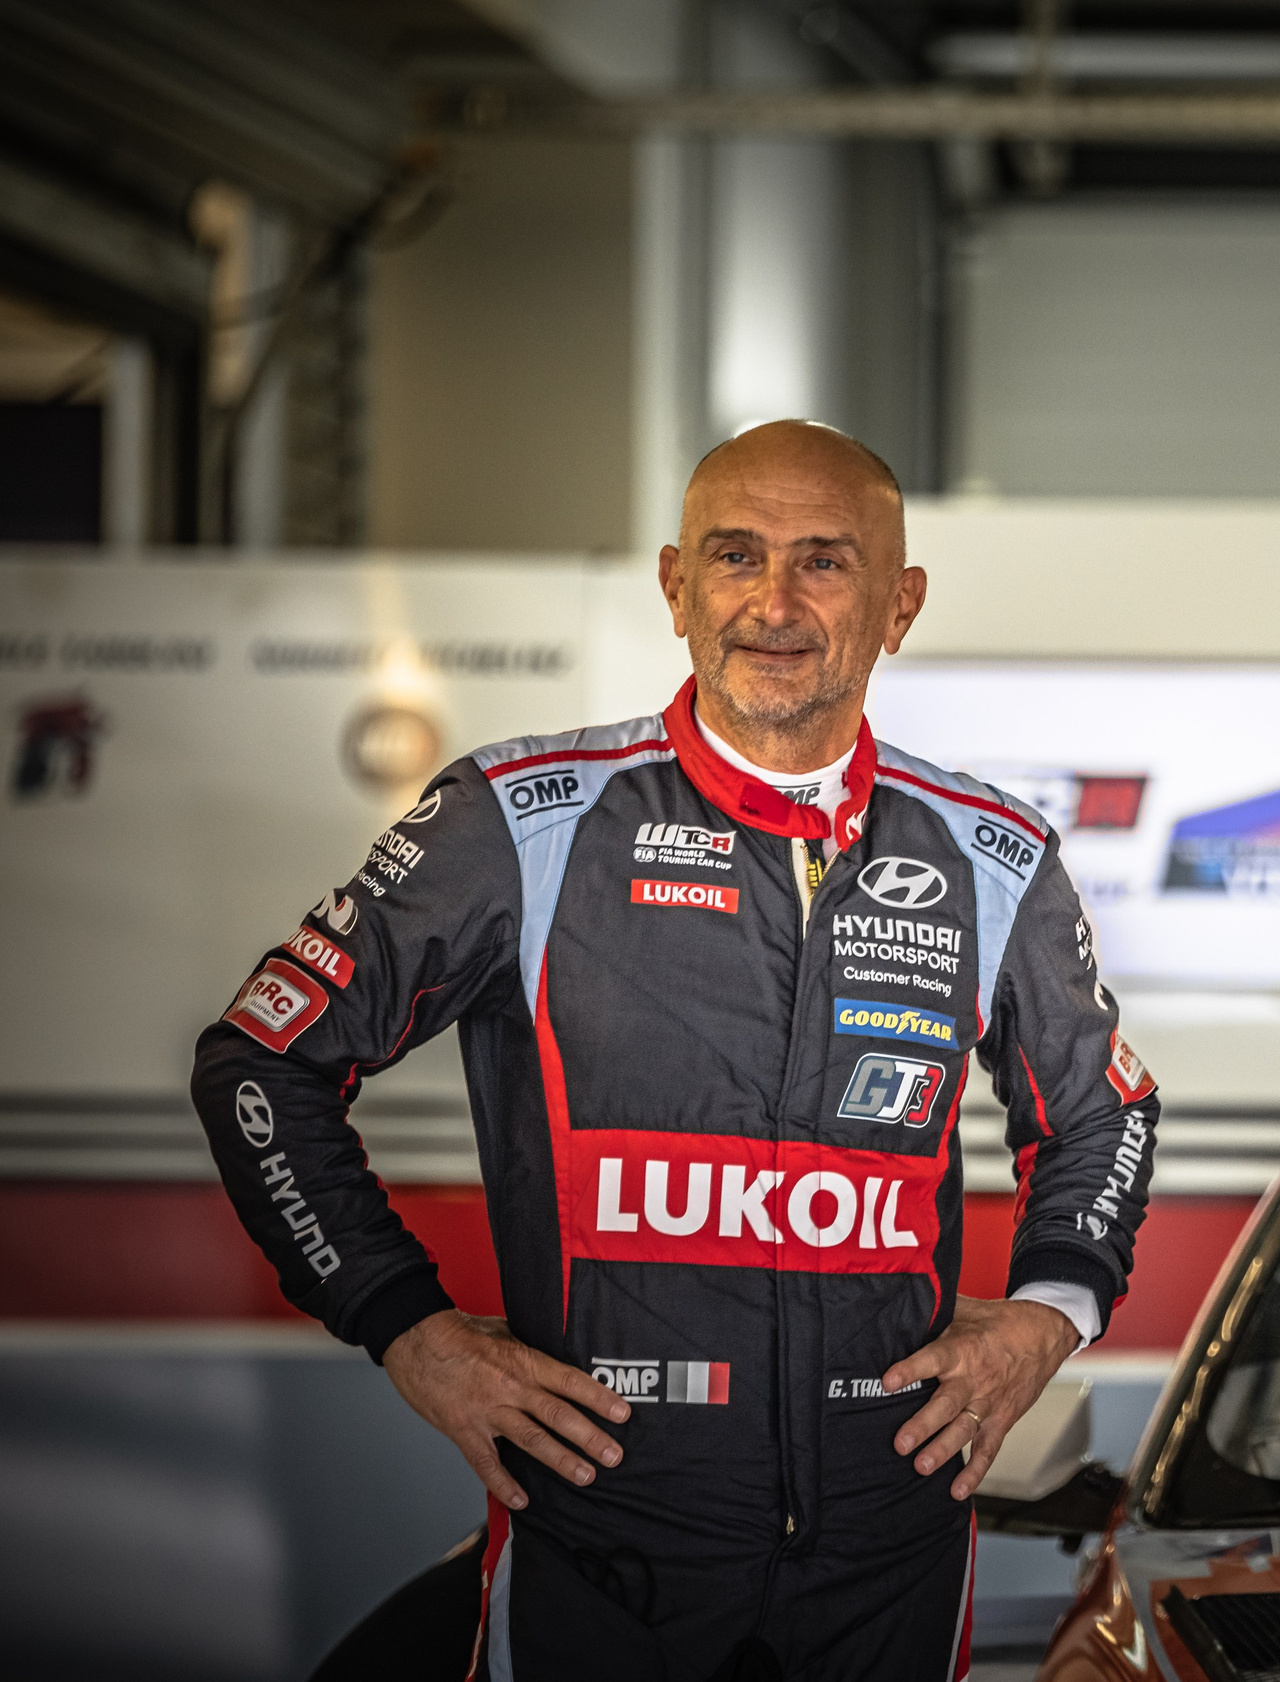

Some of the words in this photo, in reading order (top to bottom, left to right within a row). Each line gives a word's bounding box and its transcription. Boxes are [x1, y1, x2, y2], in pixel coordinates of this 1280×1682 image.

[509, 776, 579, 810] OMP
[782, 786, 821, 806] MP
[634, 822, 737, 855] WTCR
[658, 847, 674, 856] FIA
[674, 849, 706, 858] WORLD
[974, 824, 1034, 869] OMP
[657, 856, 696, 866] TOURING
[696, 858, 715, 868] CAR
[715, 860, 733, 871] CUP
[642, 883, 726, 909] LUKOIL
[832, 914, 962, 954] HYUNDAI
[834, 940, 960, 975] MOTORSPORT
[248, 980, 294, 1015] BRC
[843, 966, 911, 986] Customer
[912, 974, 953, 998] Racing
[839, 1009, 952, 1041] GOODYEAR
[259, 1151, 341, 1278] HYUND
[596, 1157, 920, 1250] LUKOIL
[591, 1366, 660, 1395] OMP
[827, 1379, 848, 1398] G.
